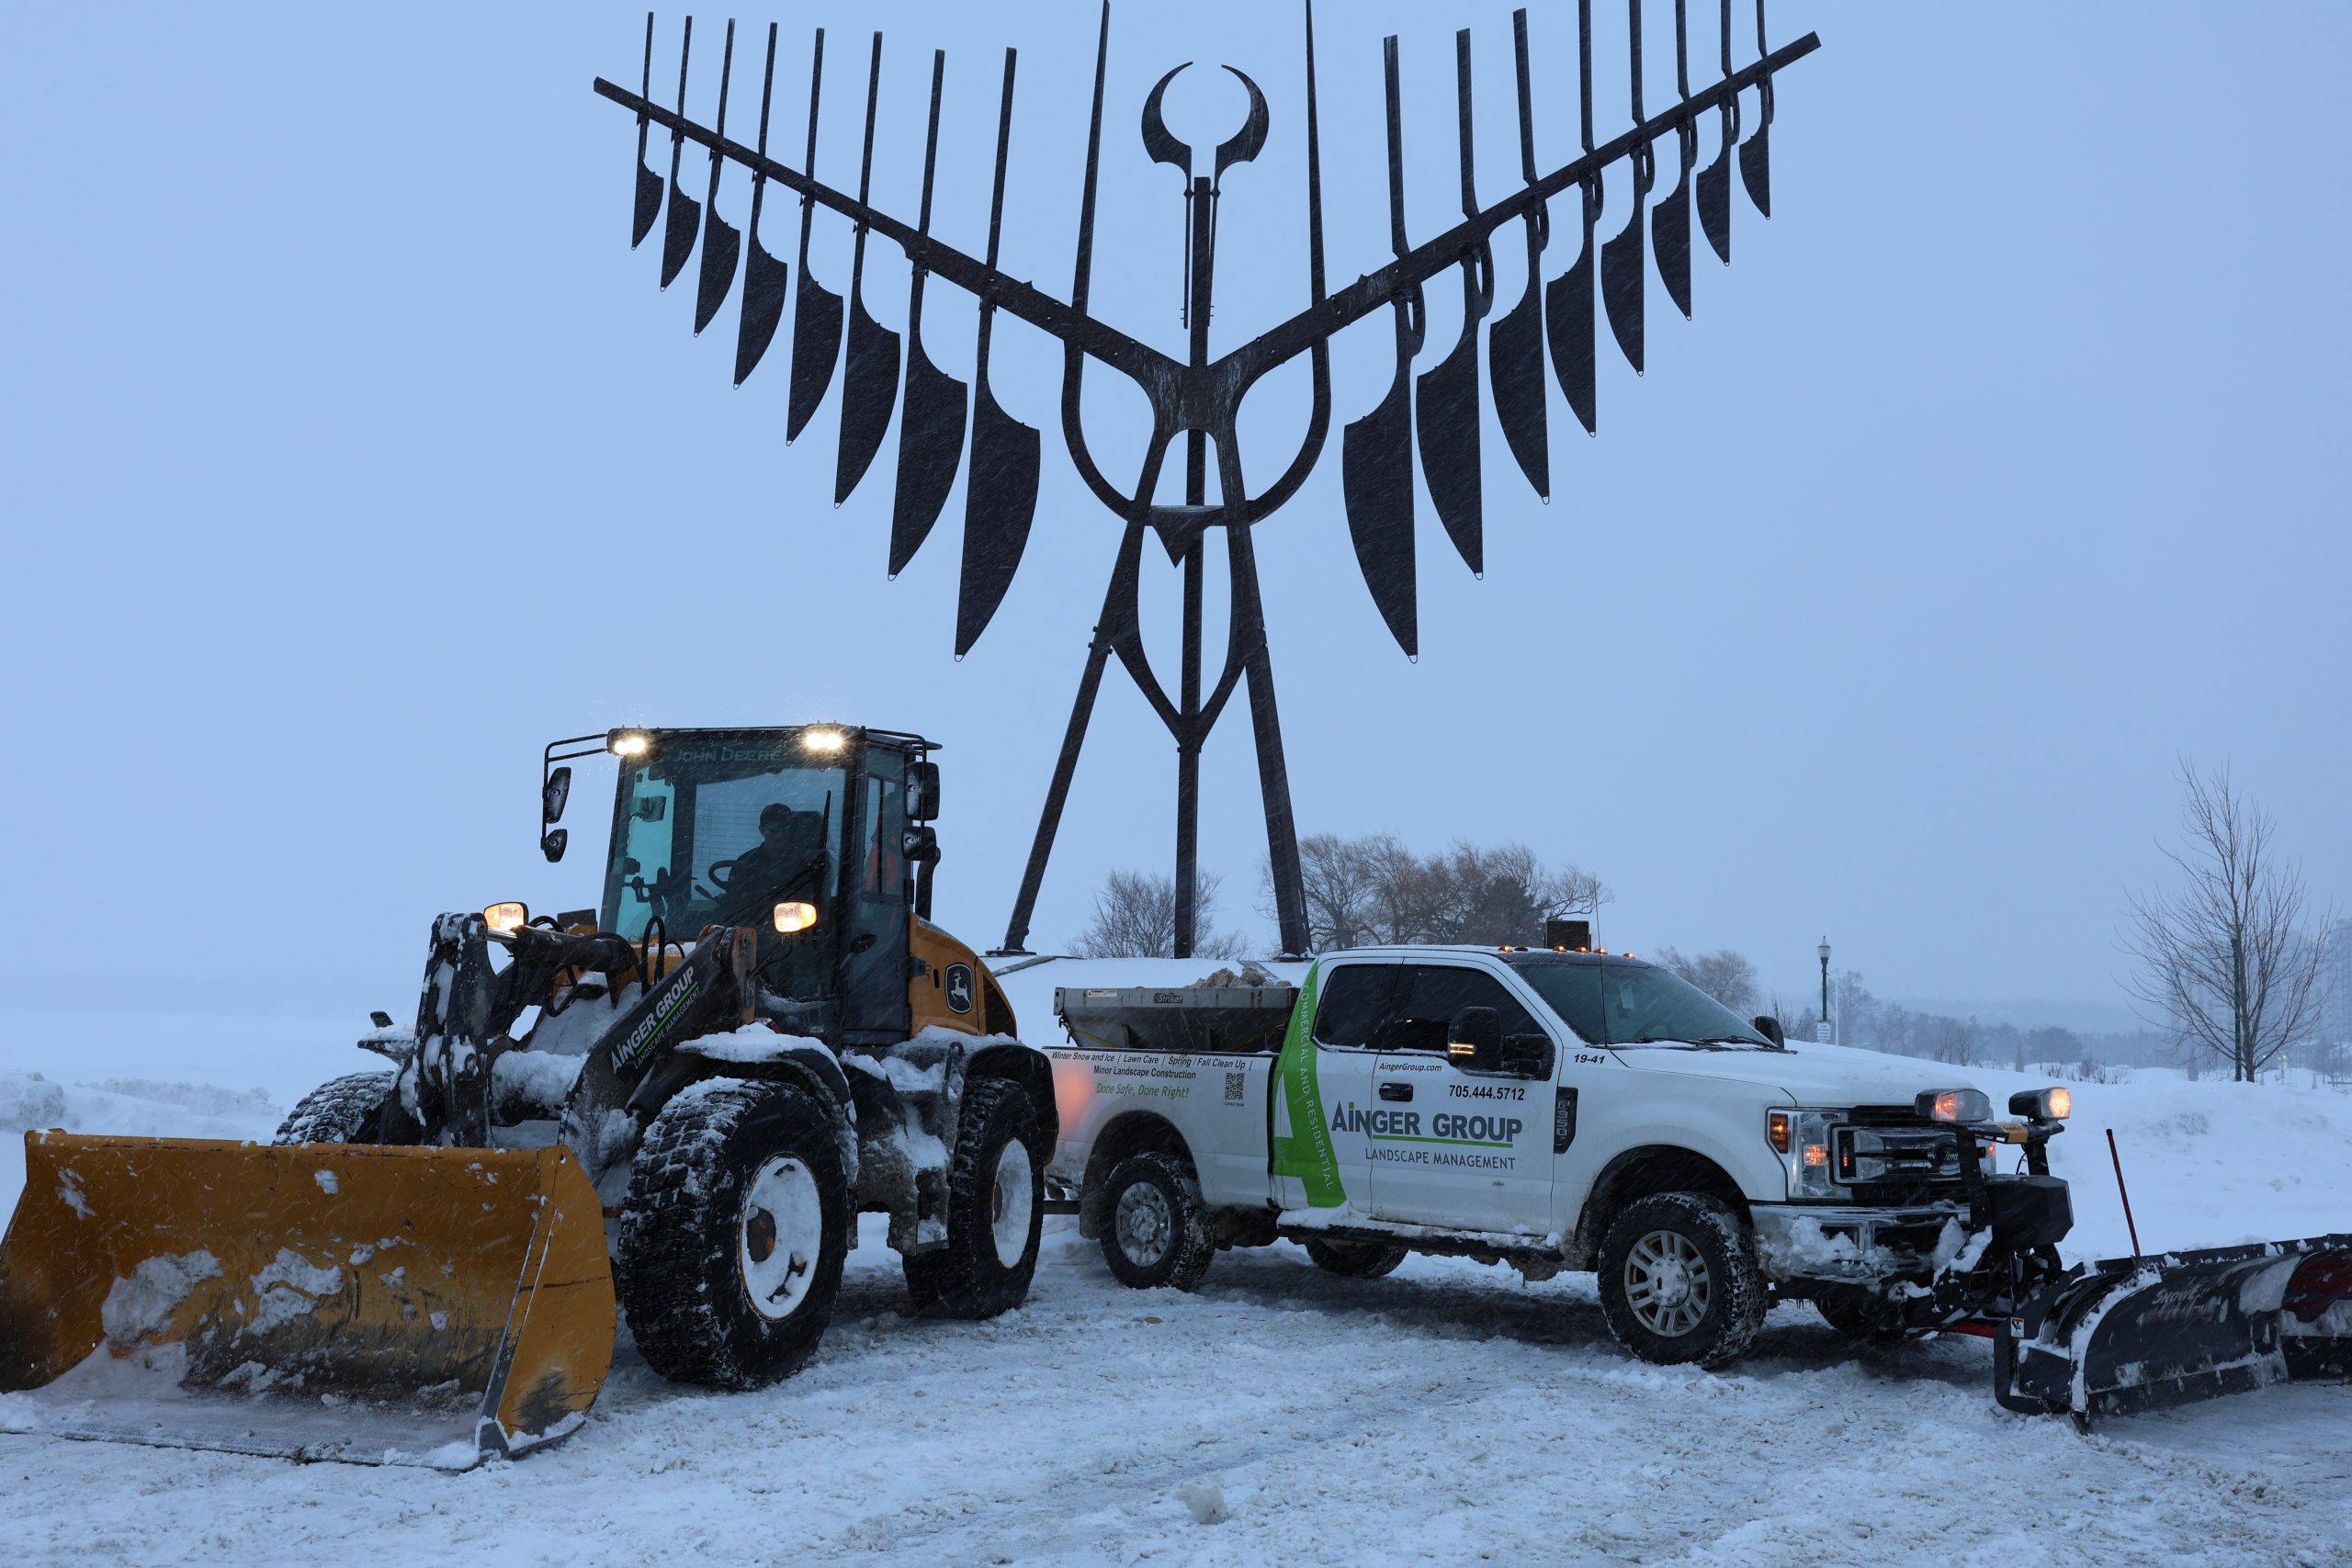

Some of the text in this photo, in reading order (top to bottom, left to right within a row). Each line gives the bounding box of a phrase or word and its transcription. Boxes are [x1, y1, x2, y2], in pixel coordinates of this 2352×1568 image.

[673, 748, 781, 762] JOHN DEERE
[655, 965, 694, 1019] GROUP
[634, 986, 701, 1069] LANDSCAPE MANAGEMENT
[1052, 1051, 1072, 1060] Winter
[1072, 1052, 1091, 1061] Snow
[1091, 1054, 1104, 1062] and
[1104, 1054, 1114, 1062] Ice
[1124, 1055, 1141, 1063] Lawn
[1143, 1055, 1159, 1064] Care
[1168, 1056, 1192, 1067] Spring
[1197, 1057, 1211, 1066] Fall
[1213, 1058, 1233, 1068] Clean
[1235, 1060, 1246, 1070] Up
[1378, 1062, 1442, 1073] AingerGroup.com
[1574, 1054, 1605, 1064] 19-41
[1093, 1066, 1196, 1079] Minor Landscape Construction
[1096, 1083, 1190, 1100] Done Safe, Done Right!
[1300, 985, 1332, 1190] COMMERCIAL AND RESIDENTIAL
[1449, 1085, 1525, 1101] 705.444.5712
[1432, 1112, 1523, 1143] GROUP
[1365, 1147, 1516, 1170] LANDSCAPE MANAGEMENT
